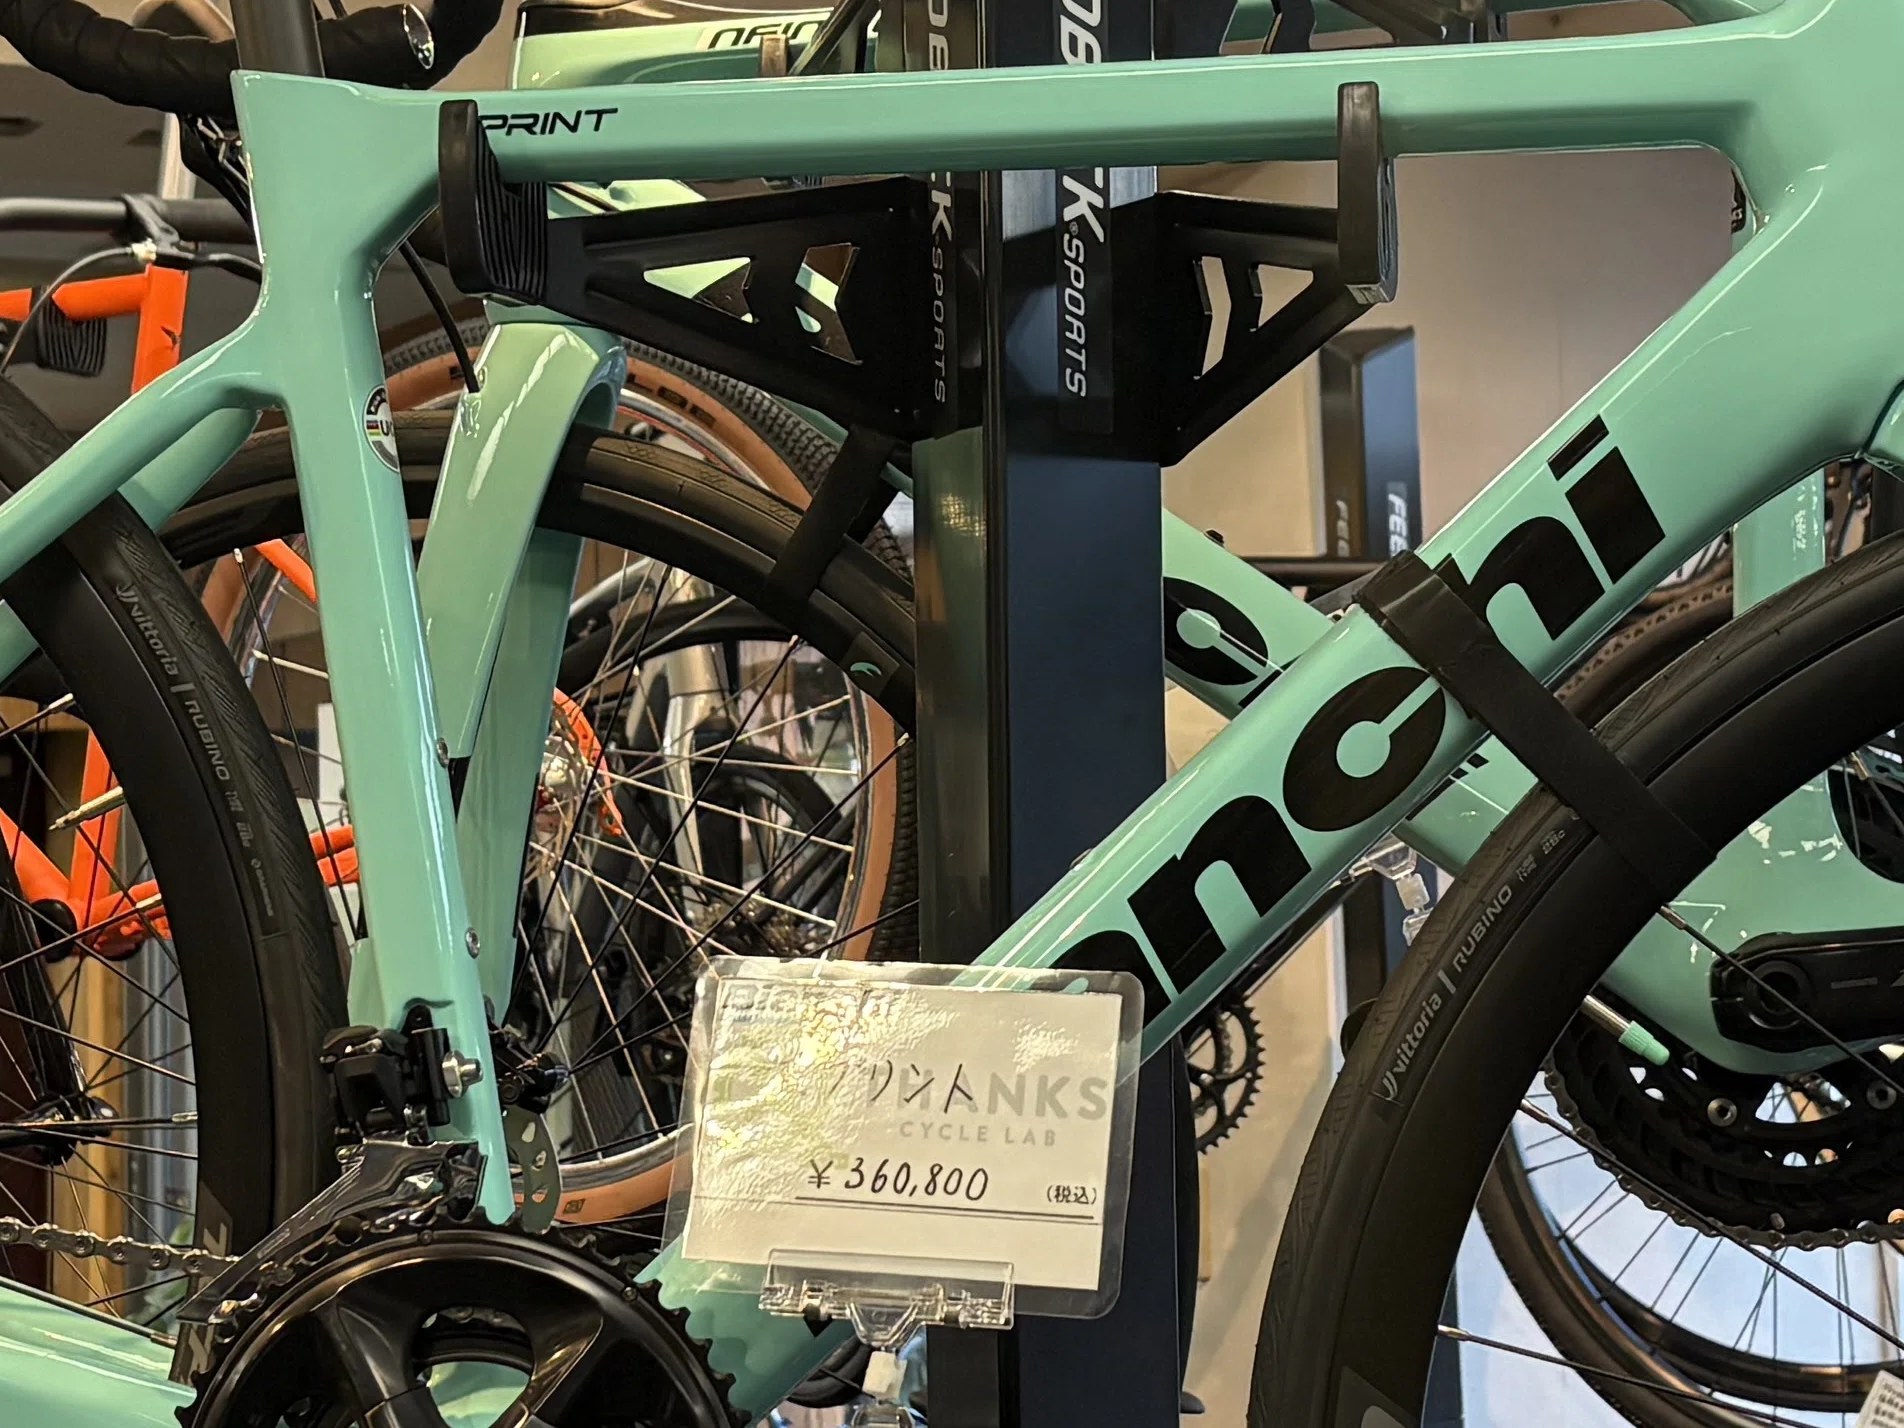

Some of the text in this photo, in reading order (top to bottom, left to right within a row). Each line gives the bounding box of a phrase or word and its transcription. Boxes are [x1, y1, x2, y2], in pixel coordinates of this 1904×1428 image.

[479, 108, 620, 137] PRINT
[932, 252, 950, 404] SPORTS
[1060, 232, 1089, 399] SPORTS
[183, 698, 231, 782] RUBINO
[1452, 884, 1513, 973] RUBINO
[899, 1119, 1058, 1148] CYCLE LAB
